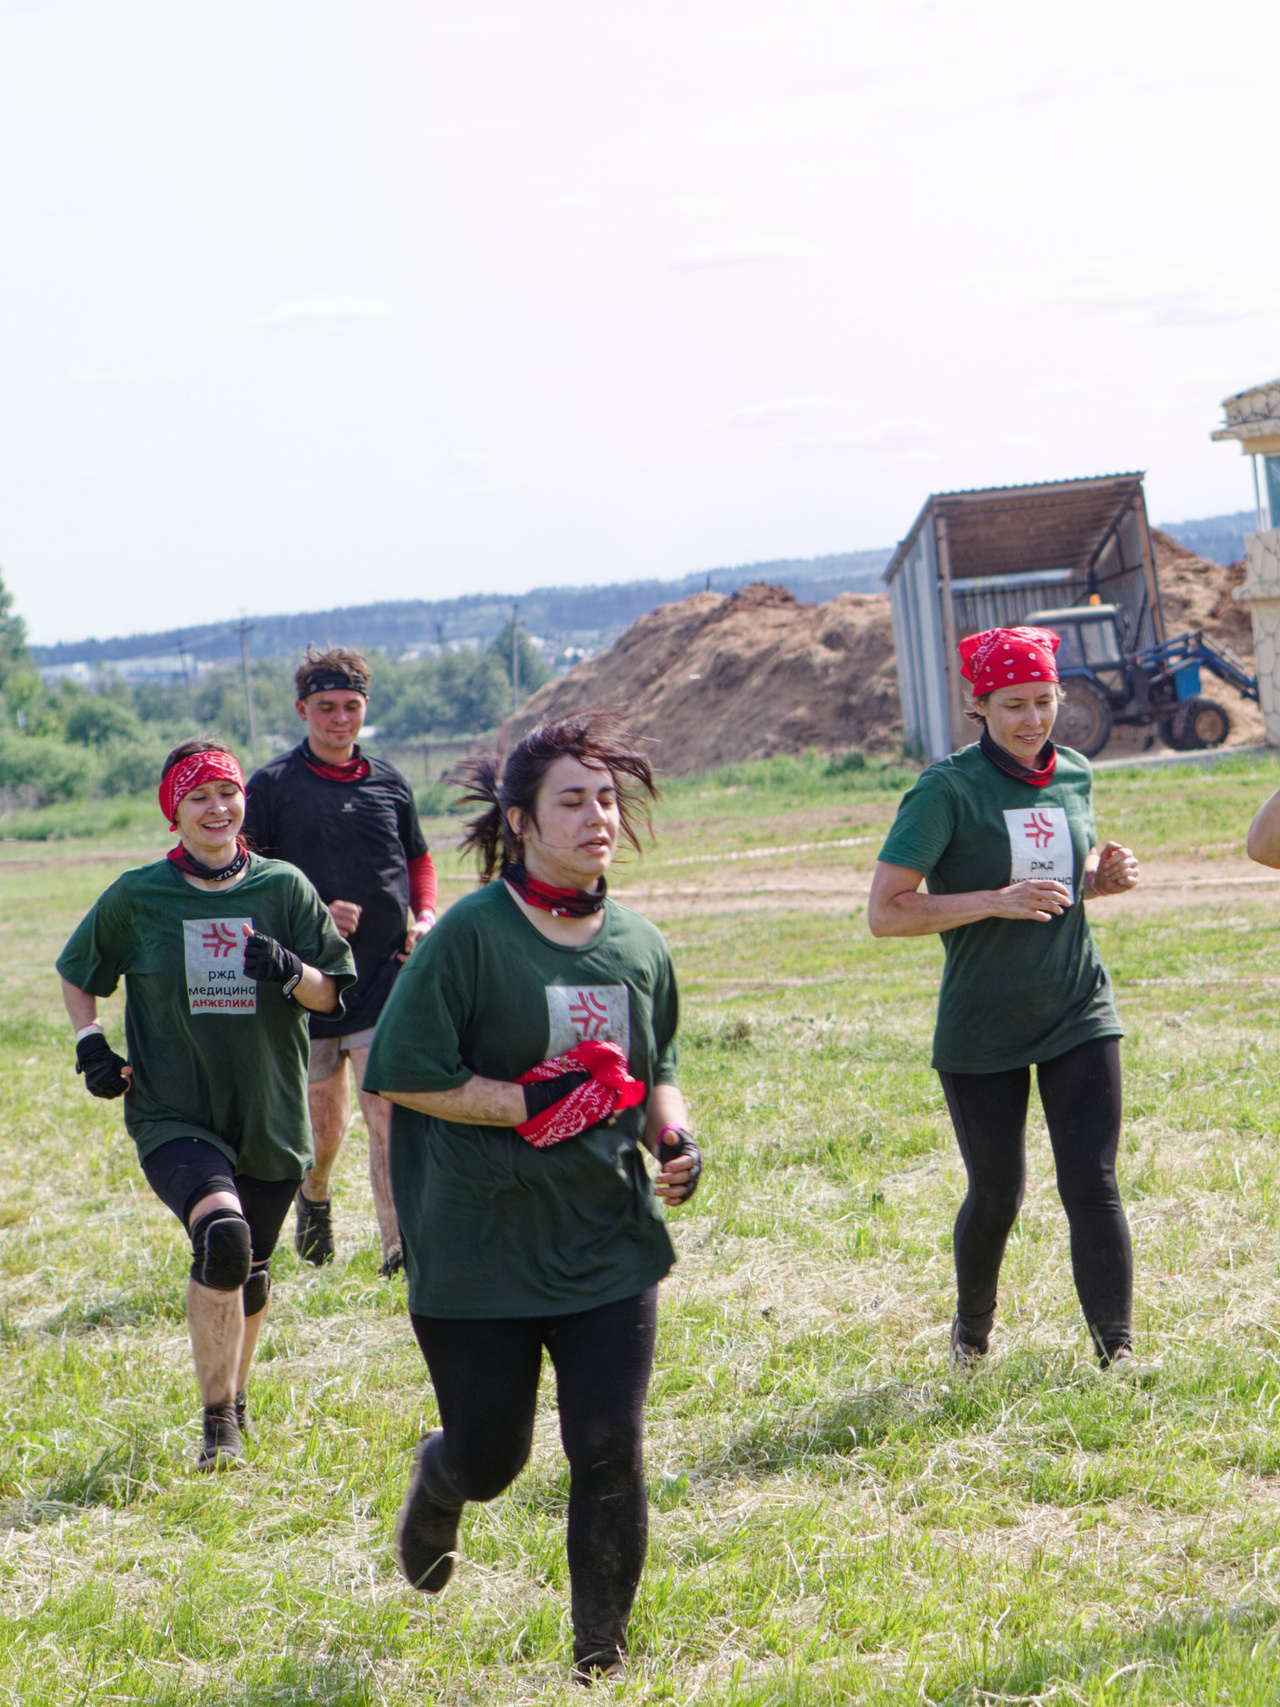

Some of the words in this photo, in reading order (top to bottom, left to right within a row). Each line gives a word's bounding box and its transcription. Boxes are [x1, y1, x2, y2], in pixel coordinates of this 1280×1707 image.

[1031, 861, 1054, 872] ржд
[208, 970, 236, 982] ржд
[192, 999, 255, 1008] АНЖЕЛИКА
